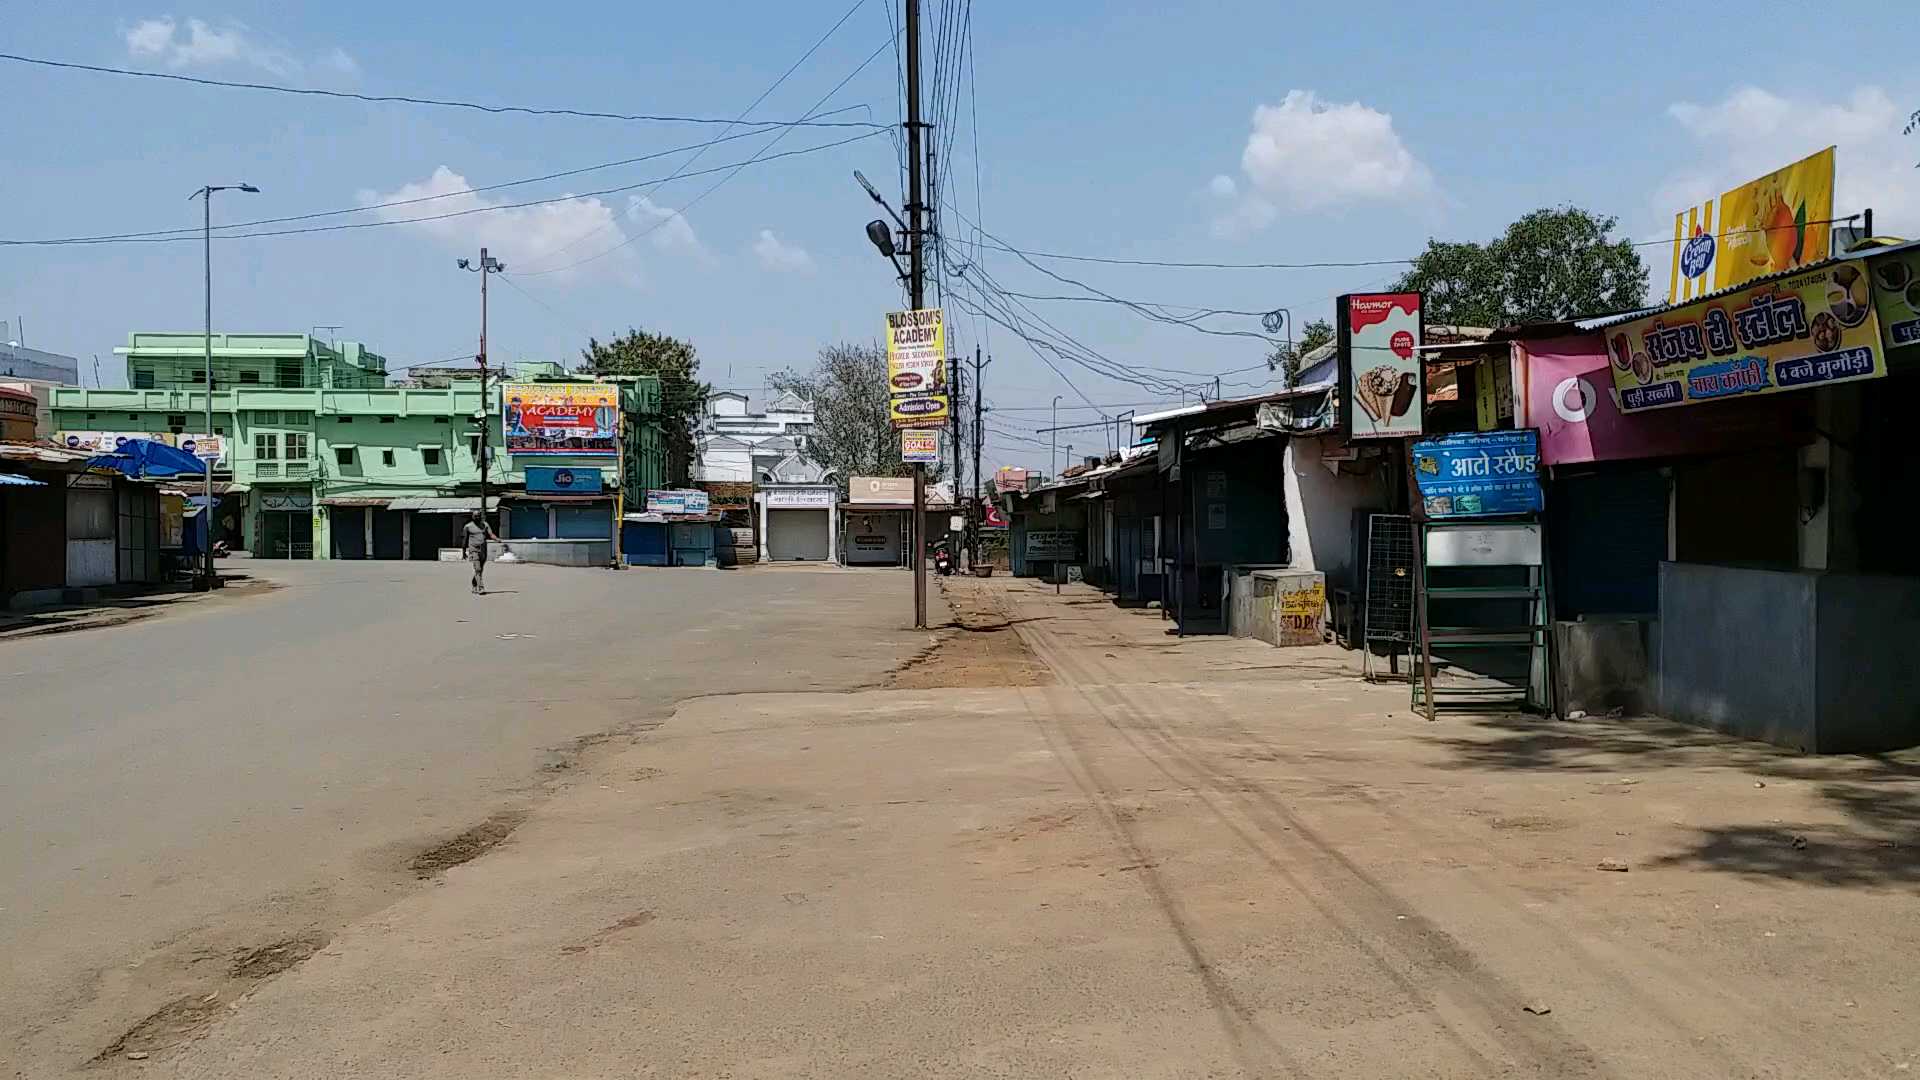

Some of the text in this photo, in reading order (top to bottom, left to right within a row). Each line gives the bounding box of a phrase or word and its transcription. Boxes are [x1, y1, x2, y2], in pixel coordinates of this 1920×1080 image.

[1684, 239, 1712, 266] Cream
[1688, 252, 1707, 279] Bell
[1352, 299, 1393, 310] Havmor
[889, 311, 942, 328] BLOSSOM'S
[893, 327, 938, 345] ACADEMY
[1645, 295, 1808, 363] संजय टी स्टॉल
[1779, 368, 1787, 381] 4
[1646, 384, 1675, 402] सब्जी
[526, 405, 596, 416] ACADEMY
[925, 401, 941, 411] Open
[1451, 450, 1490, 477] आटो
[555, 473, 572, 483] Jio
